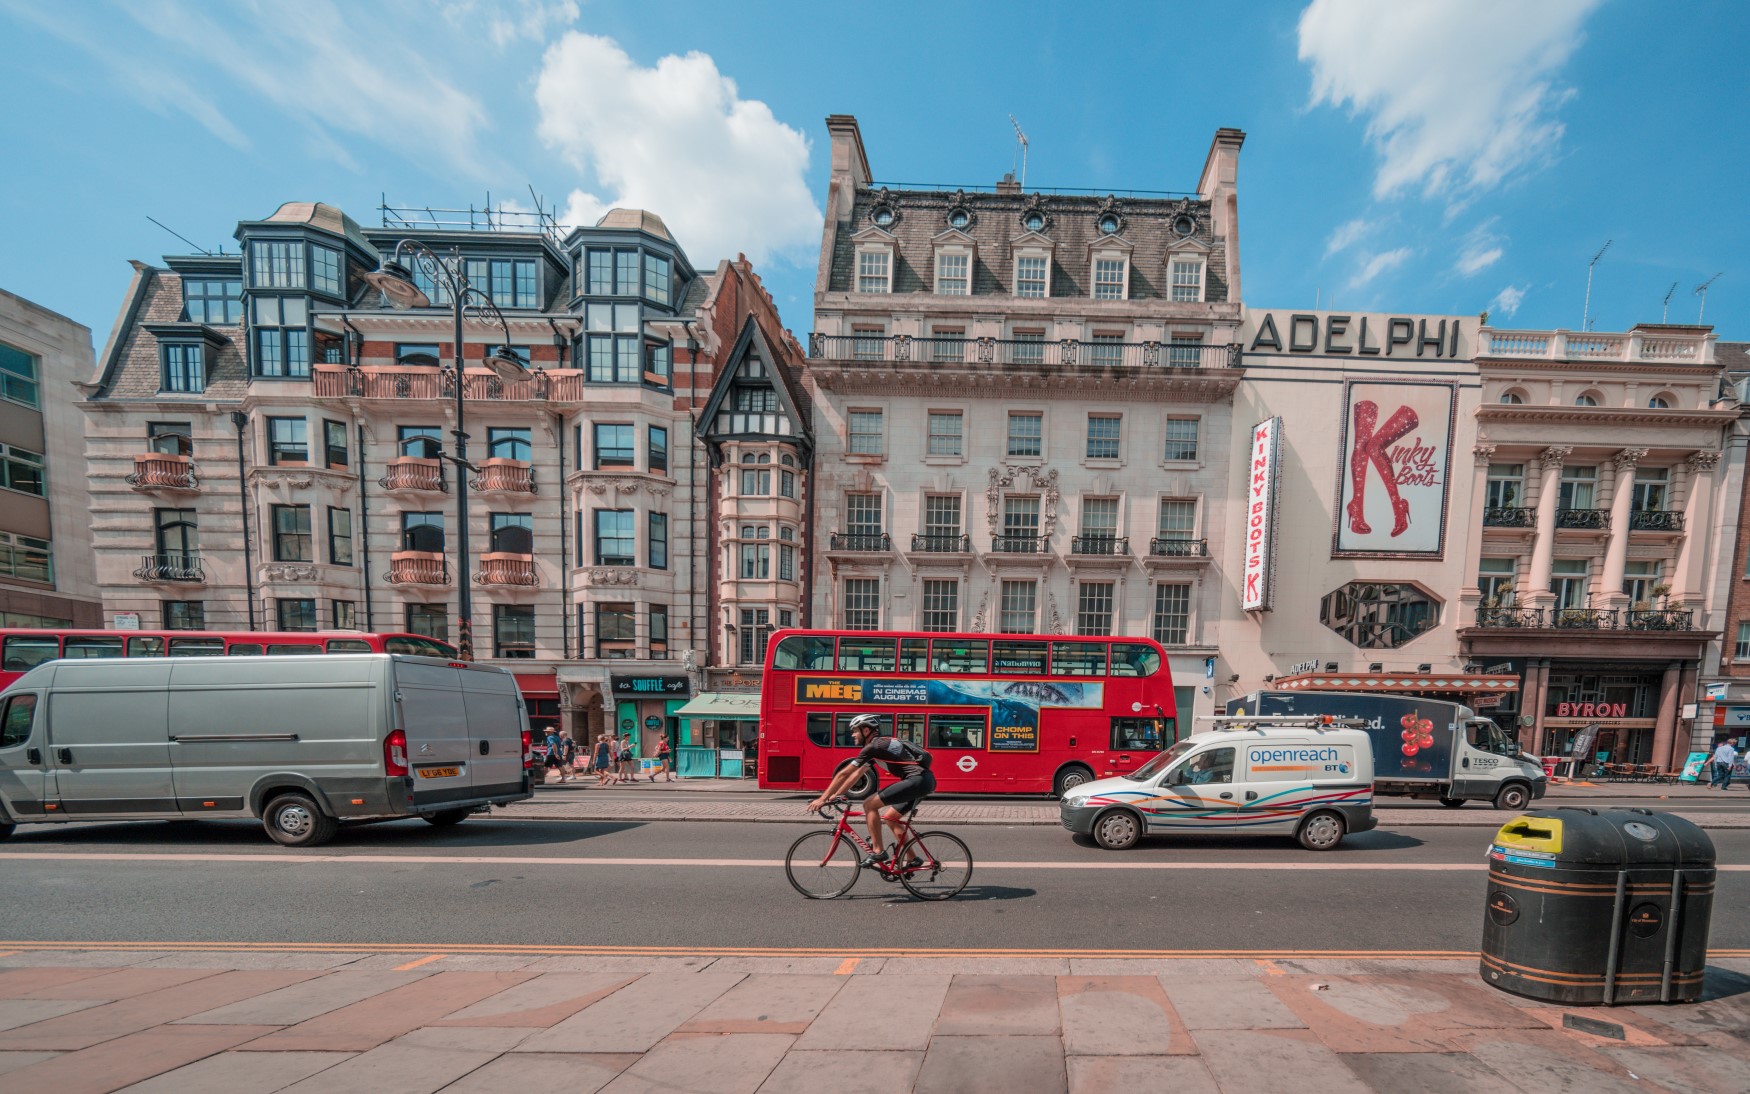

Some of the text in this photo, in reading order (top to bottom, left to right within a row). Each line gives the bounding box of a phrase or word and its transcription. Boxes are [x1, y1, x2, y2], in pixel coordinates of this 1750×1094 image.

[1250, 313, 1460, 357] ADELPHI
[1253, 426, 1268, 497] KINKY
[1395, 465, 1442, 487] Boots
[1249, 501, 1263, 568] BOOTS
[806, 684, 862, 701] MEG
[1557, 702, 1627, 717] BYRON
[1250, 747, 1338, 764] openreach
